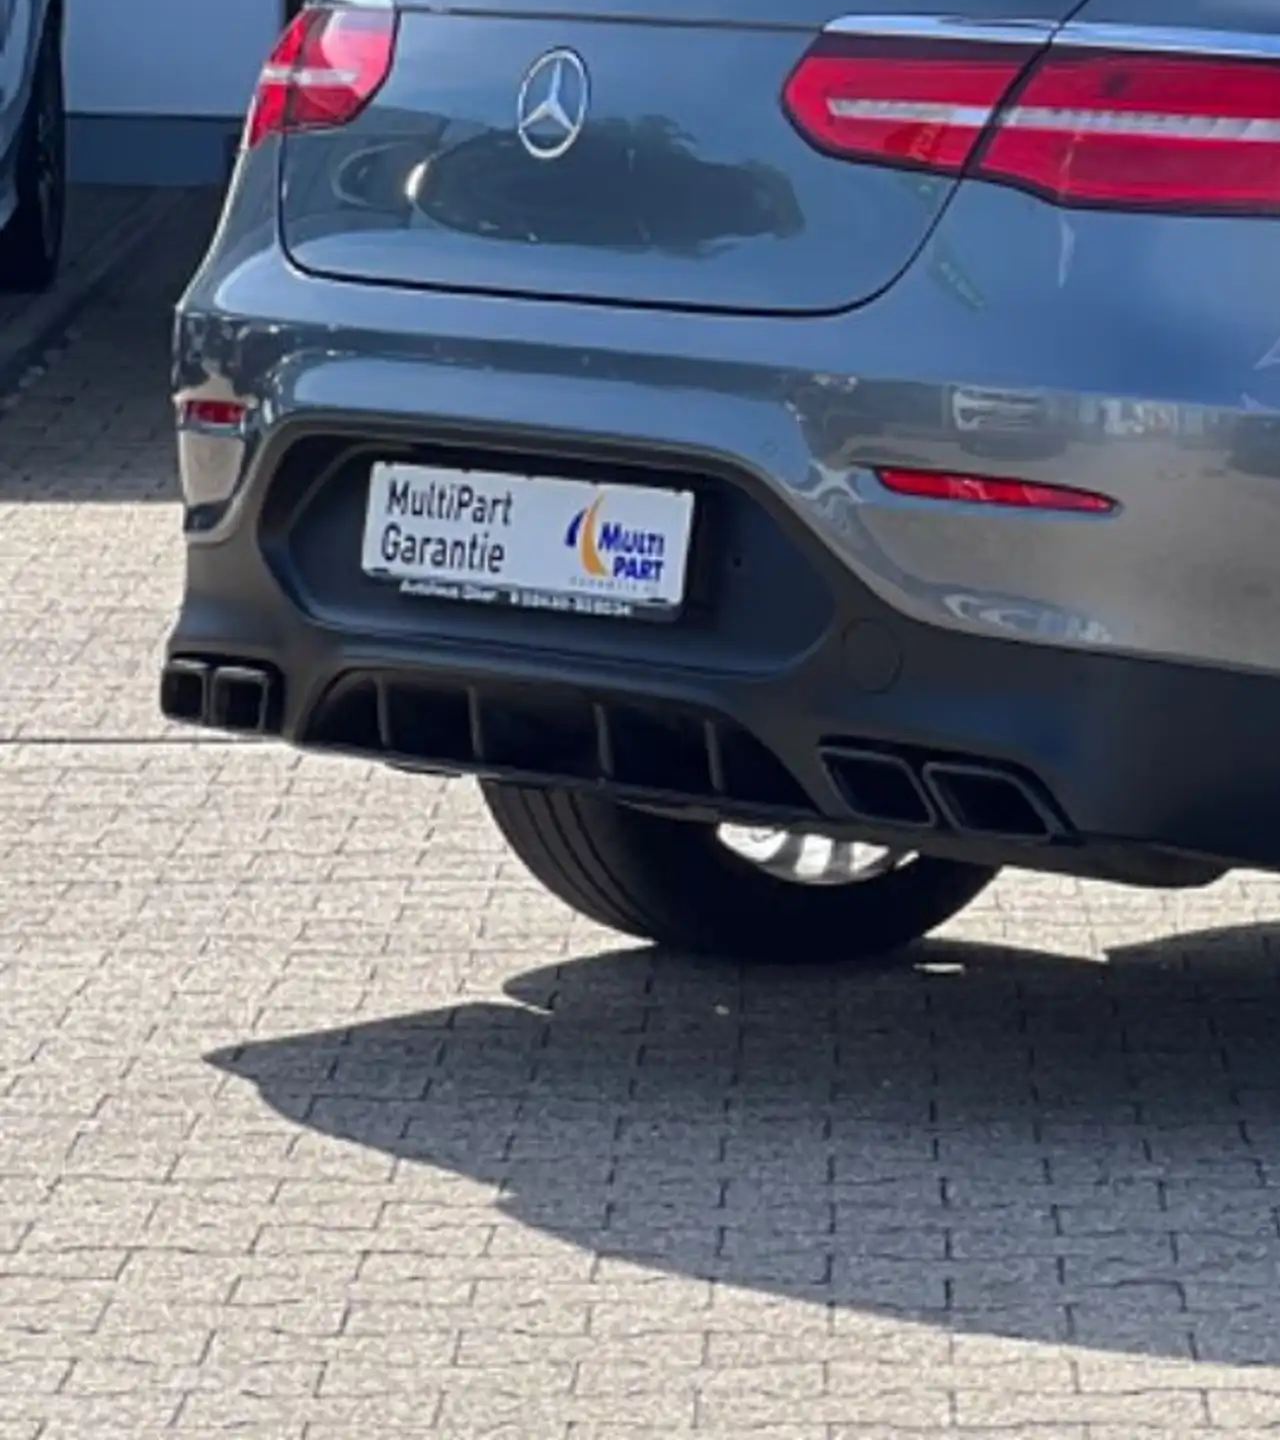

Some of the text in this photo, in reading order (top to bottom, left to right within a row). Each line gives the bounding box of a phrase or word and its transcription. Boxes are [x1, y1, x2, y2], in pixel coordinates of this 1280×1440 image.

[385, 478, 513, 526] MultiPart
[381, 521, 505, 574] Garantie
[612, 555, 665, 582] PART
